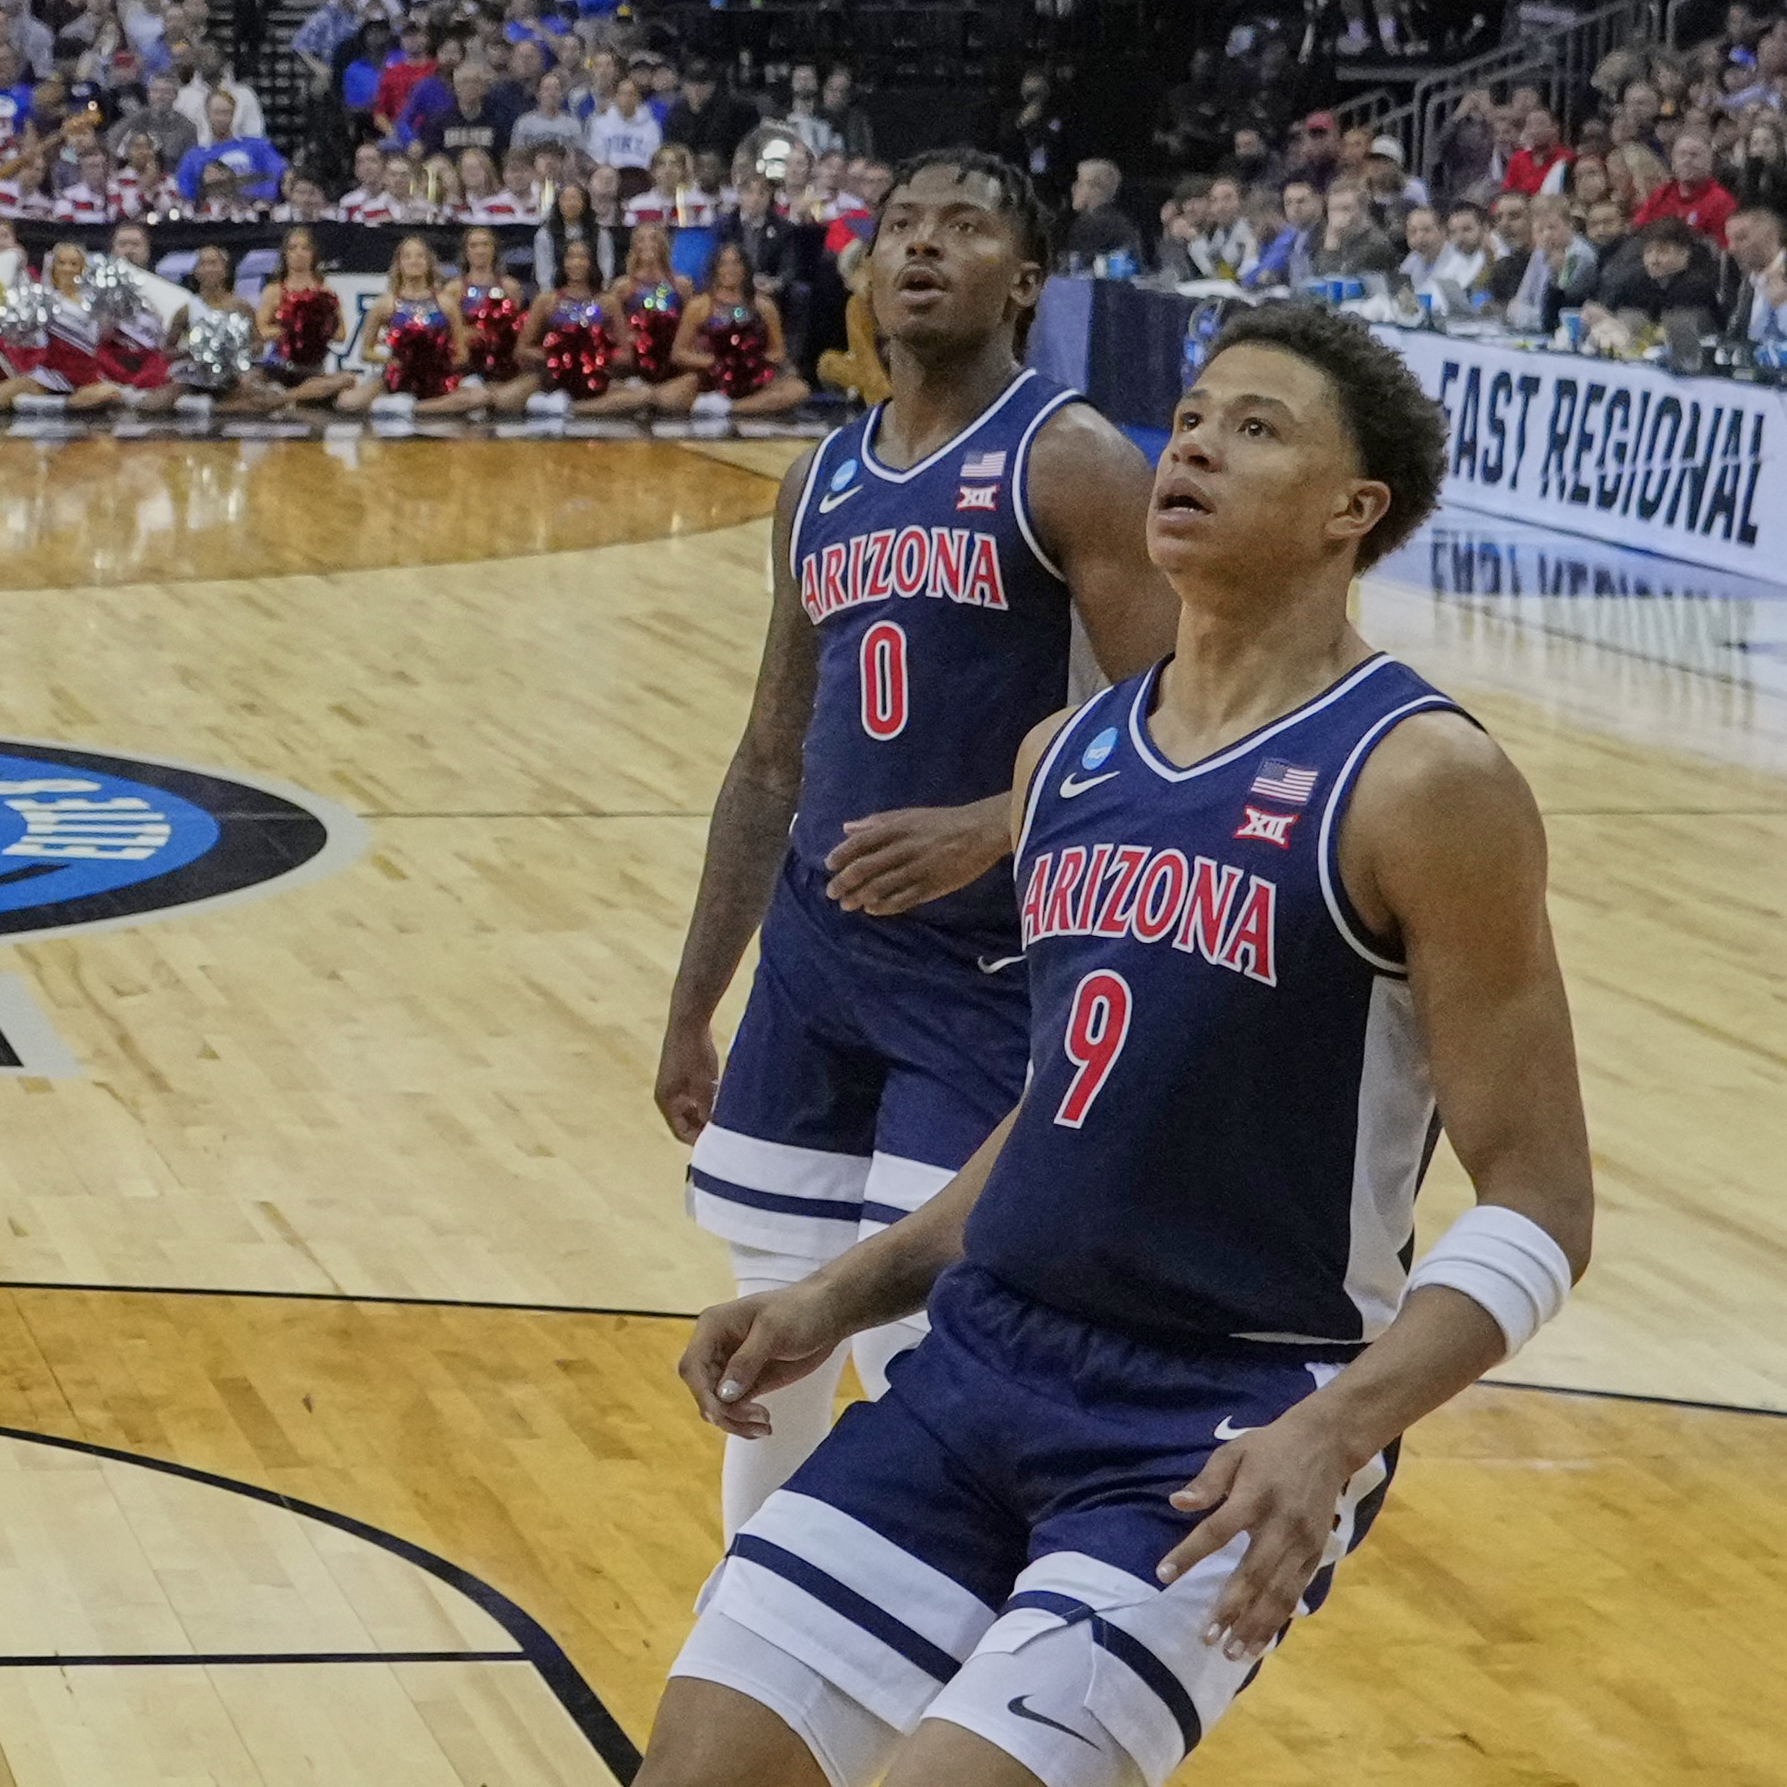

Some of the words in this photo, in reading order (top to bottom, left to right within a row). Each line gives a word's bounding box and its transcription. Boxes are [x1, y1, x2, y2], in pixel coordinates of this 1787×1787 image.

[1439, 361, 1542, 491] EAST
[1540, 375, 1765, 549] REGIONAL
[801, 525, 1009, 626] ARIZONA
[859, 620, 908, 741] 0
[2, 796, 172, 861] ELITE
[1237, 808, 1298, 846] XII
[1022, 843, 1277, 988] ARIZONA
[1053, 969, 1132, 1129] 9
